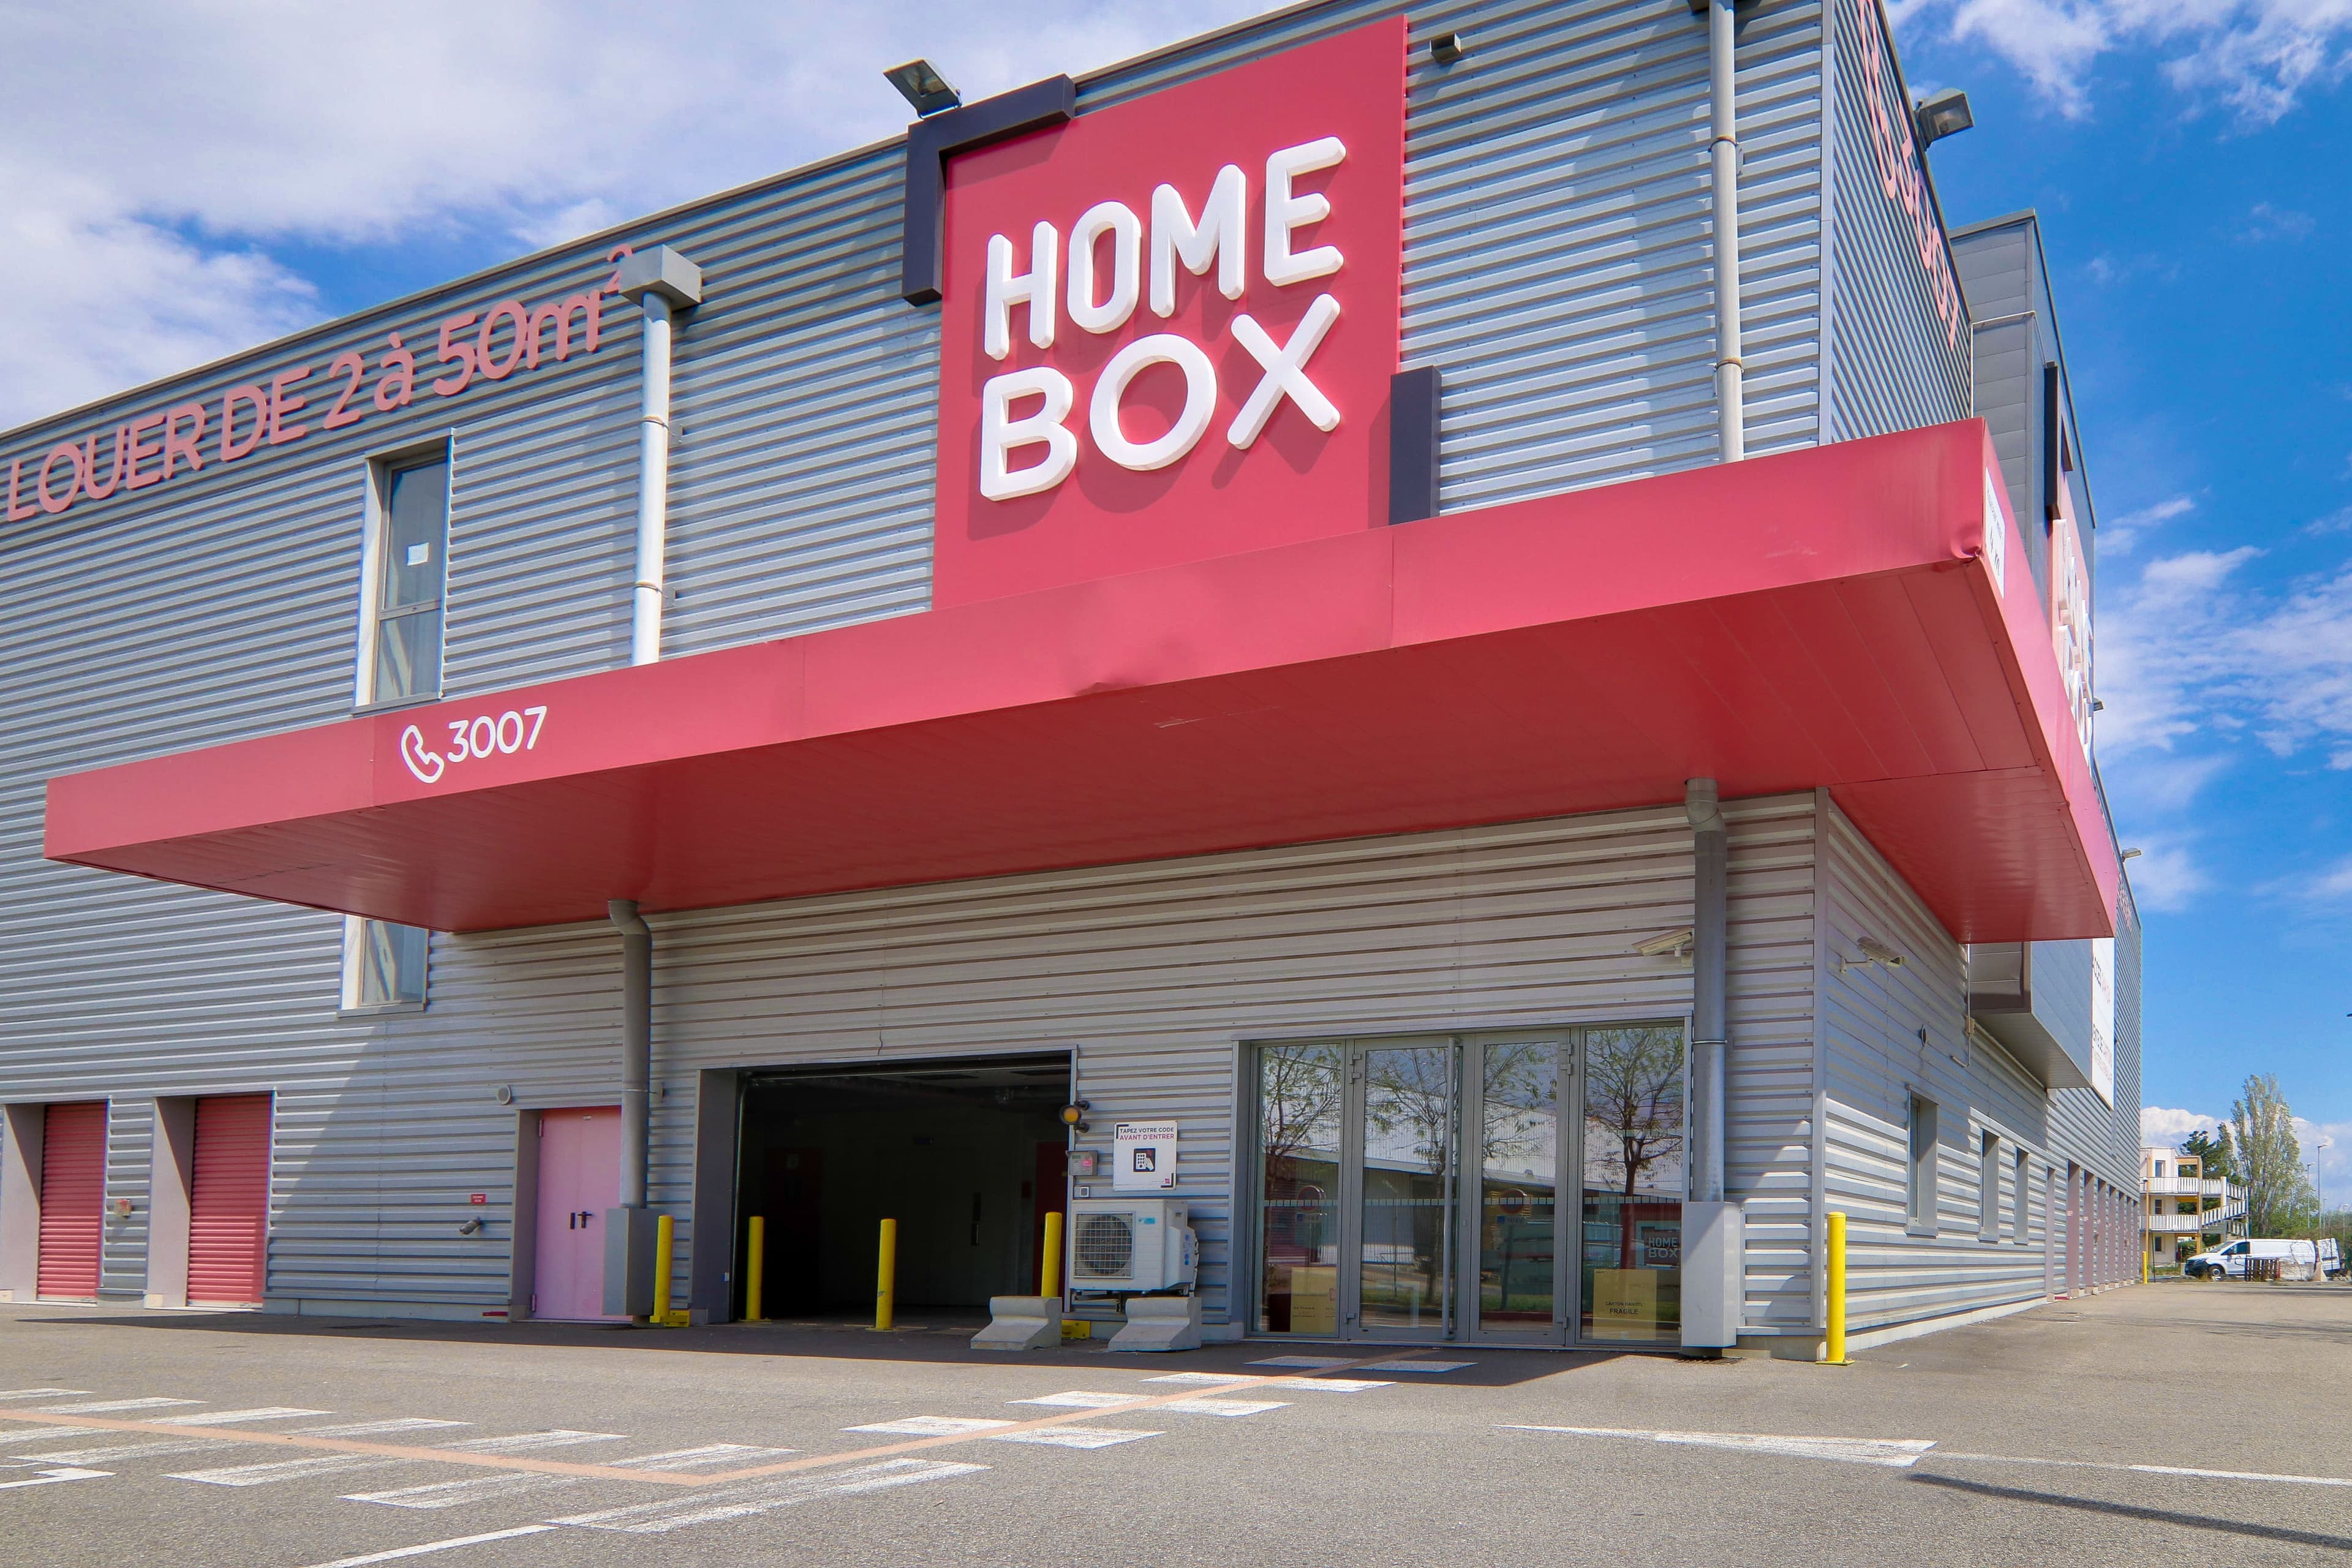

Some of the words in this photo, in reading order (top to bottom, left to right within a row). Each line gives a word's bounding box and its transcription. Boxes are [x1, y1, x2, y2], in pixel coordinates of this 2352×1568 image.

[984, 136, 1346, 361] HOME
[7, 402, 205, 521] LOUER
[219, 366, 312, 461] DE
[322, 352, 365, 430] 2
[373, 331, 416, 412] à
[980, 293, 1341, 502] BOX
[447, 706, 548, 762] 3007
[1649, 1237, 1678, 1247] HOME
[1649, 1248, 1678, 1258] BOX
